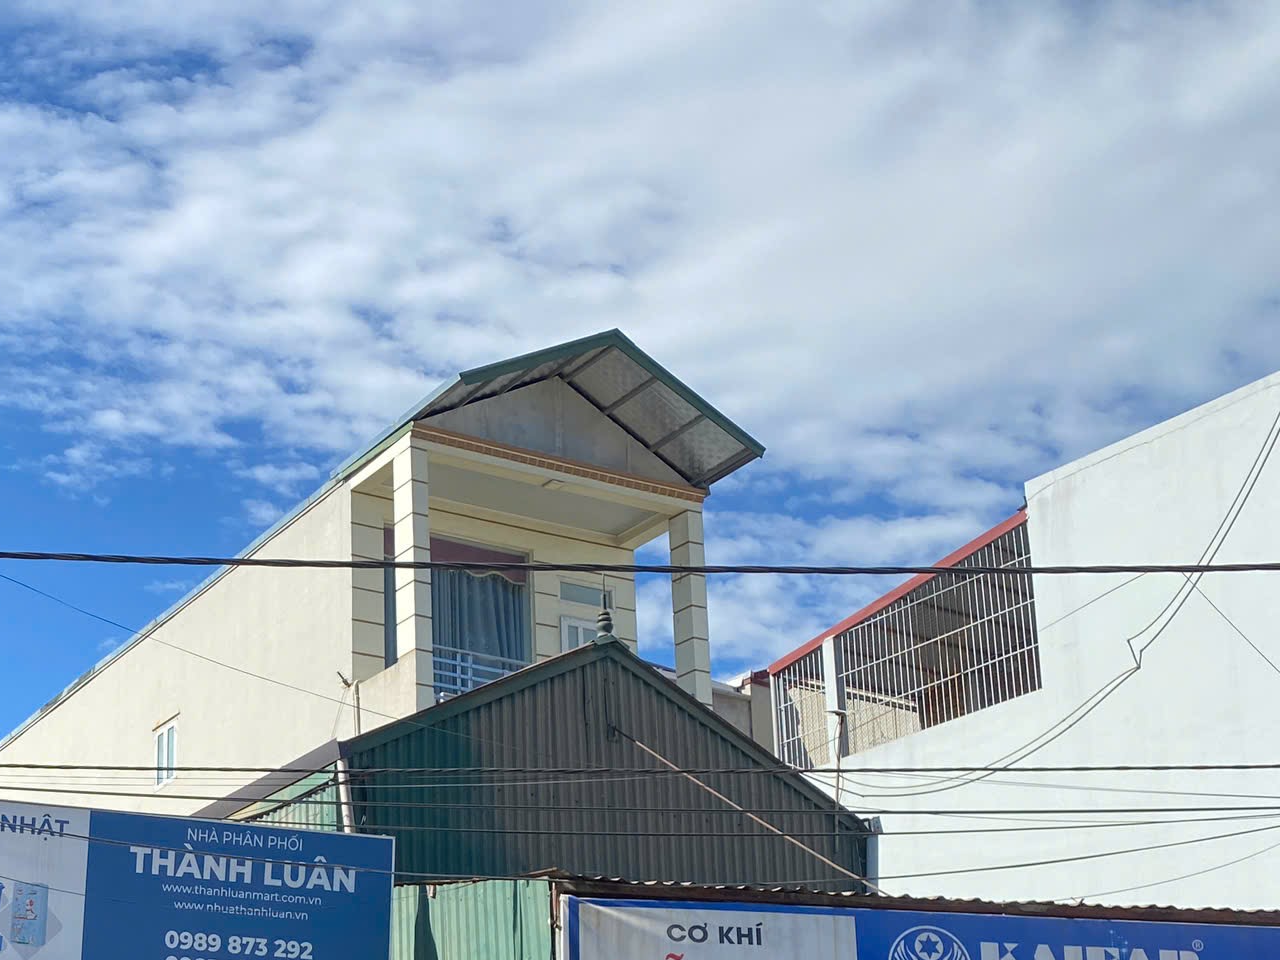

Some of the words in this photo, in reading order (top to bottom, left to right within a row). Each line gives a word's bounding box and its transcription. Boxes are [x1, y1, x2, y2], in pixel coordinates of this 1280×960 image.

[0, 814, 70, 841] NHẬT
[187, 828, 219, 844] NHÀ
[223, 830, 263, 847] PHÂN
[268, 834, 303, 851] PHỐI
[130, 844, 253, 884] THÀNH
[264, 856, 357, 893] LUÂN
[161, 882, 322, 906] www.thanhluanmart.com.vn
[173, 901, 308, 920] www.nhuathanhluan.vn
[164, 930, 221, 952] 0989
[227, 935, 268, 956] 873
[273, 939, 313, 960] 292
[666, 923, 709, 944] CƠ
[719, 922, 763, 946] KHÍ
